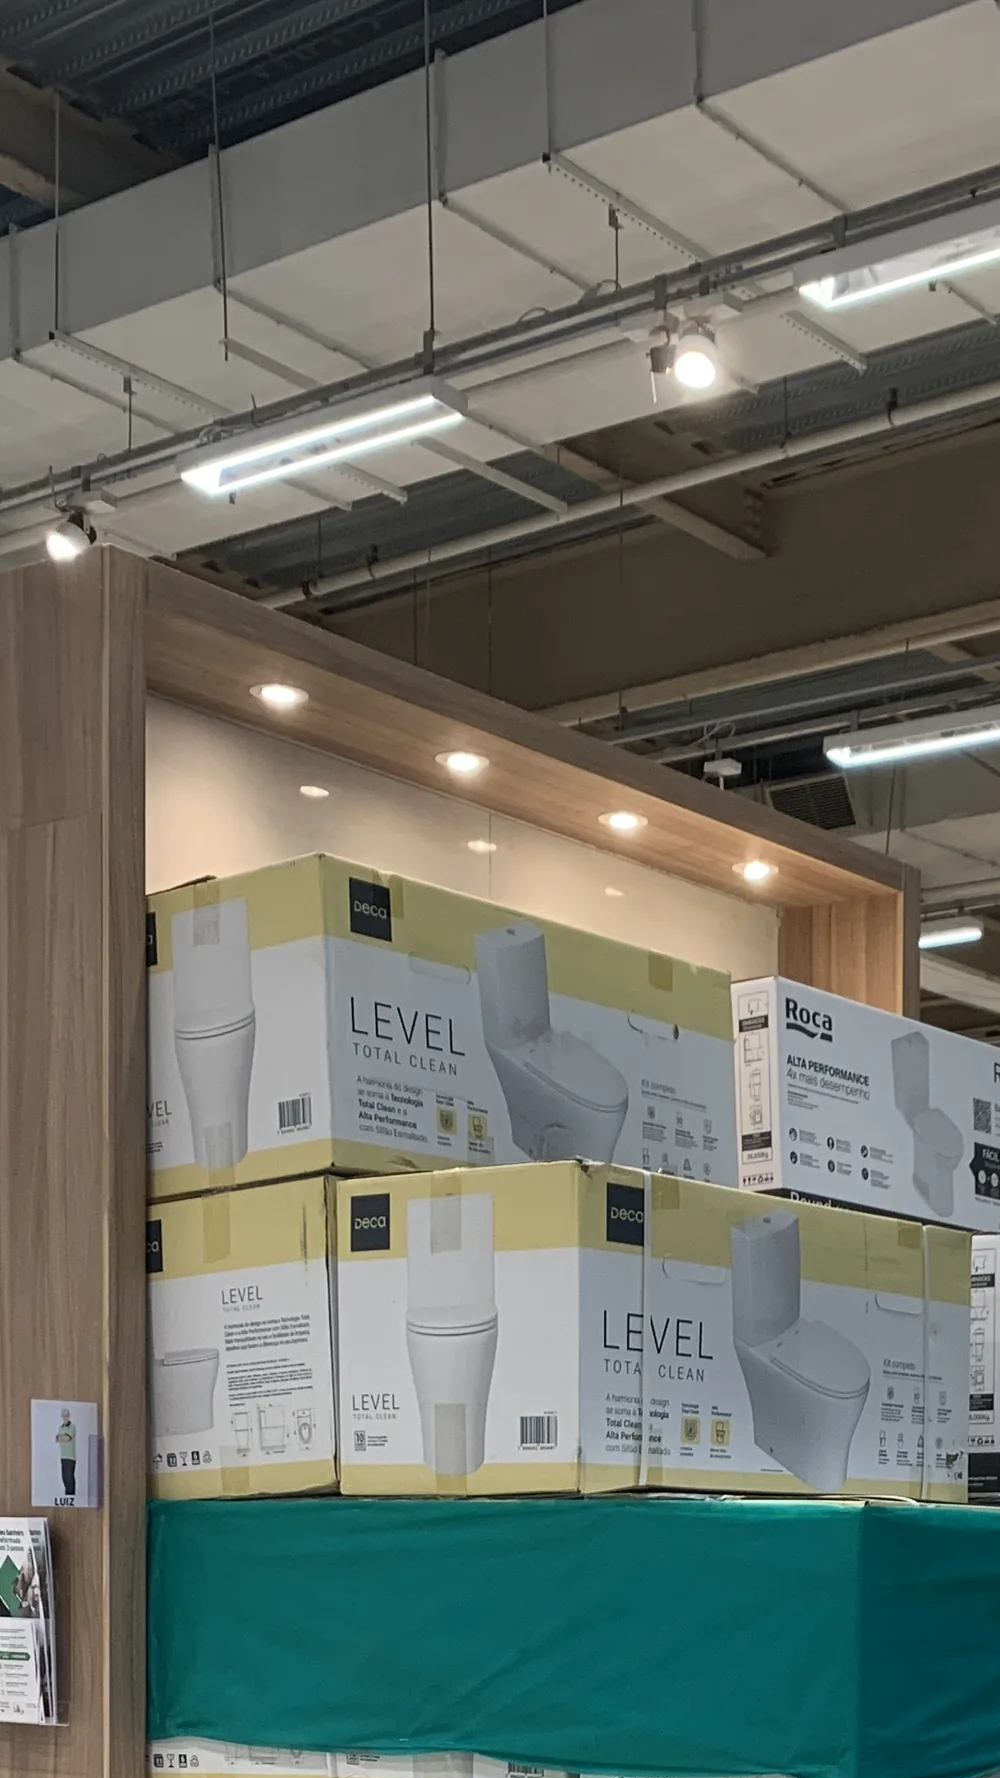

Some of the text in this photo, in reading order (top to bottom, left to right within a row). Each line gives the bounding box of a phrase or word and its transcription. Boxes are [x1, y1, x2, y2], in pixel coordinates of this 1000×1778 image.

[351, 996, 465, 1056] LEVEL
[785, 997, 833, 1031] Roca
[353, 1042, 457, 1076] TOTAL CLEAN
[787, 1054, 869, 1087] ALTA PERFORMANCE
[221, 1285, 263, 1305] LEVEL
[604, 1310, 713, 1360] LEVEL
[604, 1358, 704, 1382] TOTA CLEAN
[352, 1393, 400, 1412] LEVEL
[54, 1497, 75, 1507] LUIZ
